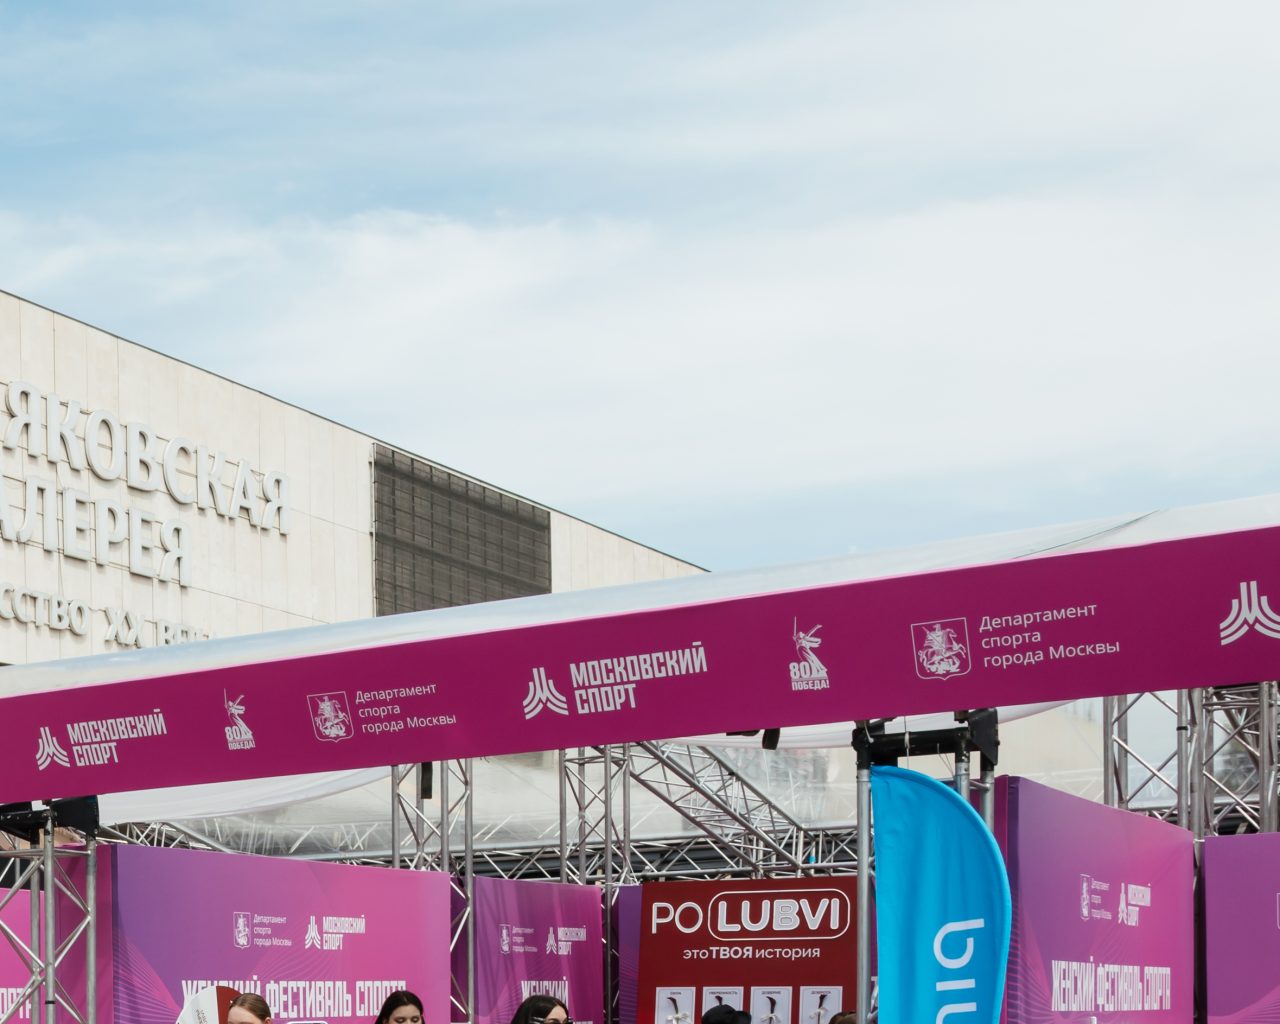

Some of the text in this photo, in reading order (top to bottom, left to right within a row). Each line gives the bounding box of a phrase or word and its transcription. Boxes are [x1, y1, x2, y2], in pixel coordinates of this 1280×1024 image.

[978, 603, 1098, 633] Департамент
[981, 630, 1041, 650] спорта
[569, 641, 708, 688] МОСКОВСКИЙ
[983, 641, 1120, 669] города Москвы
[355, 683, 437, 705] Департамент
[574, 683, 637, 715] СПОРТ
[791, 679, 830, 691] ПОБЕДА!
[358, 703, 401, 720] спорта
[361, 711, 457, 735] города Москвы
[66, 708, 168, 745] МОСКОВСКИЙ
[72, 742, 119, 767] СПОРТ
[651, 898, 840, 934] PO LUBVI
[683, 946, 821, 961] это ТВОЯ история
[1052, 956, 1095, 1011] ЖЕНСКИЙ
[1097, 963, 1142, 1012] ФЕСТИВАЛЬ
[265, 980, 352, 1018] ФЕСТИВАЛЬ
